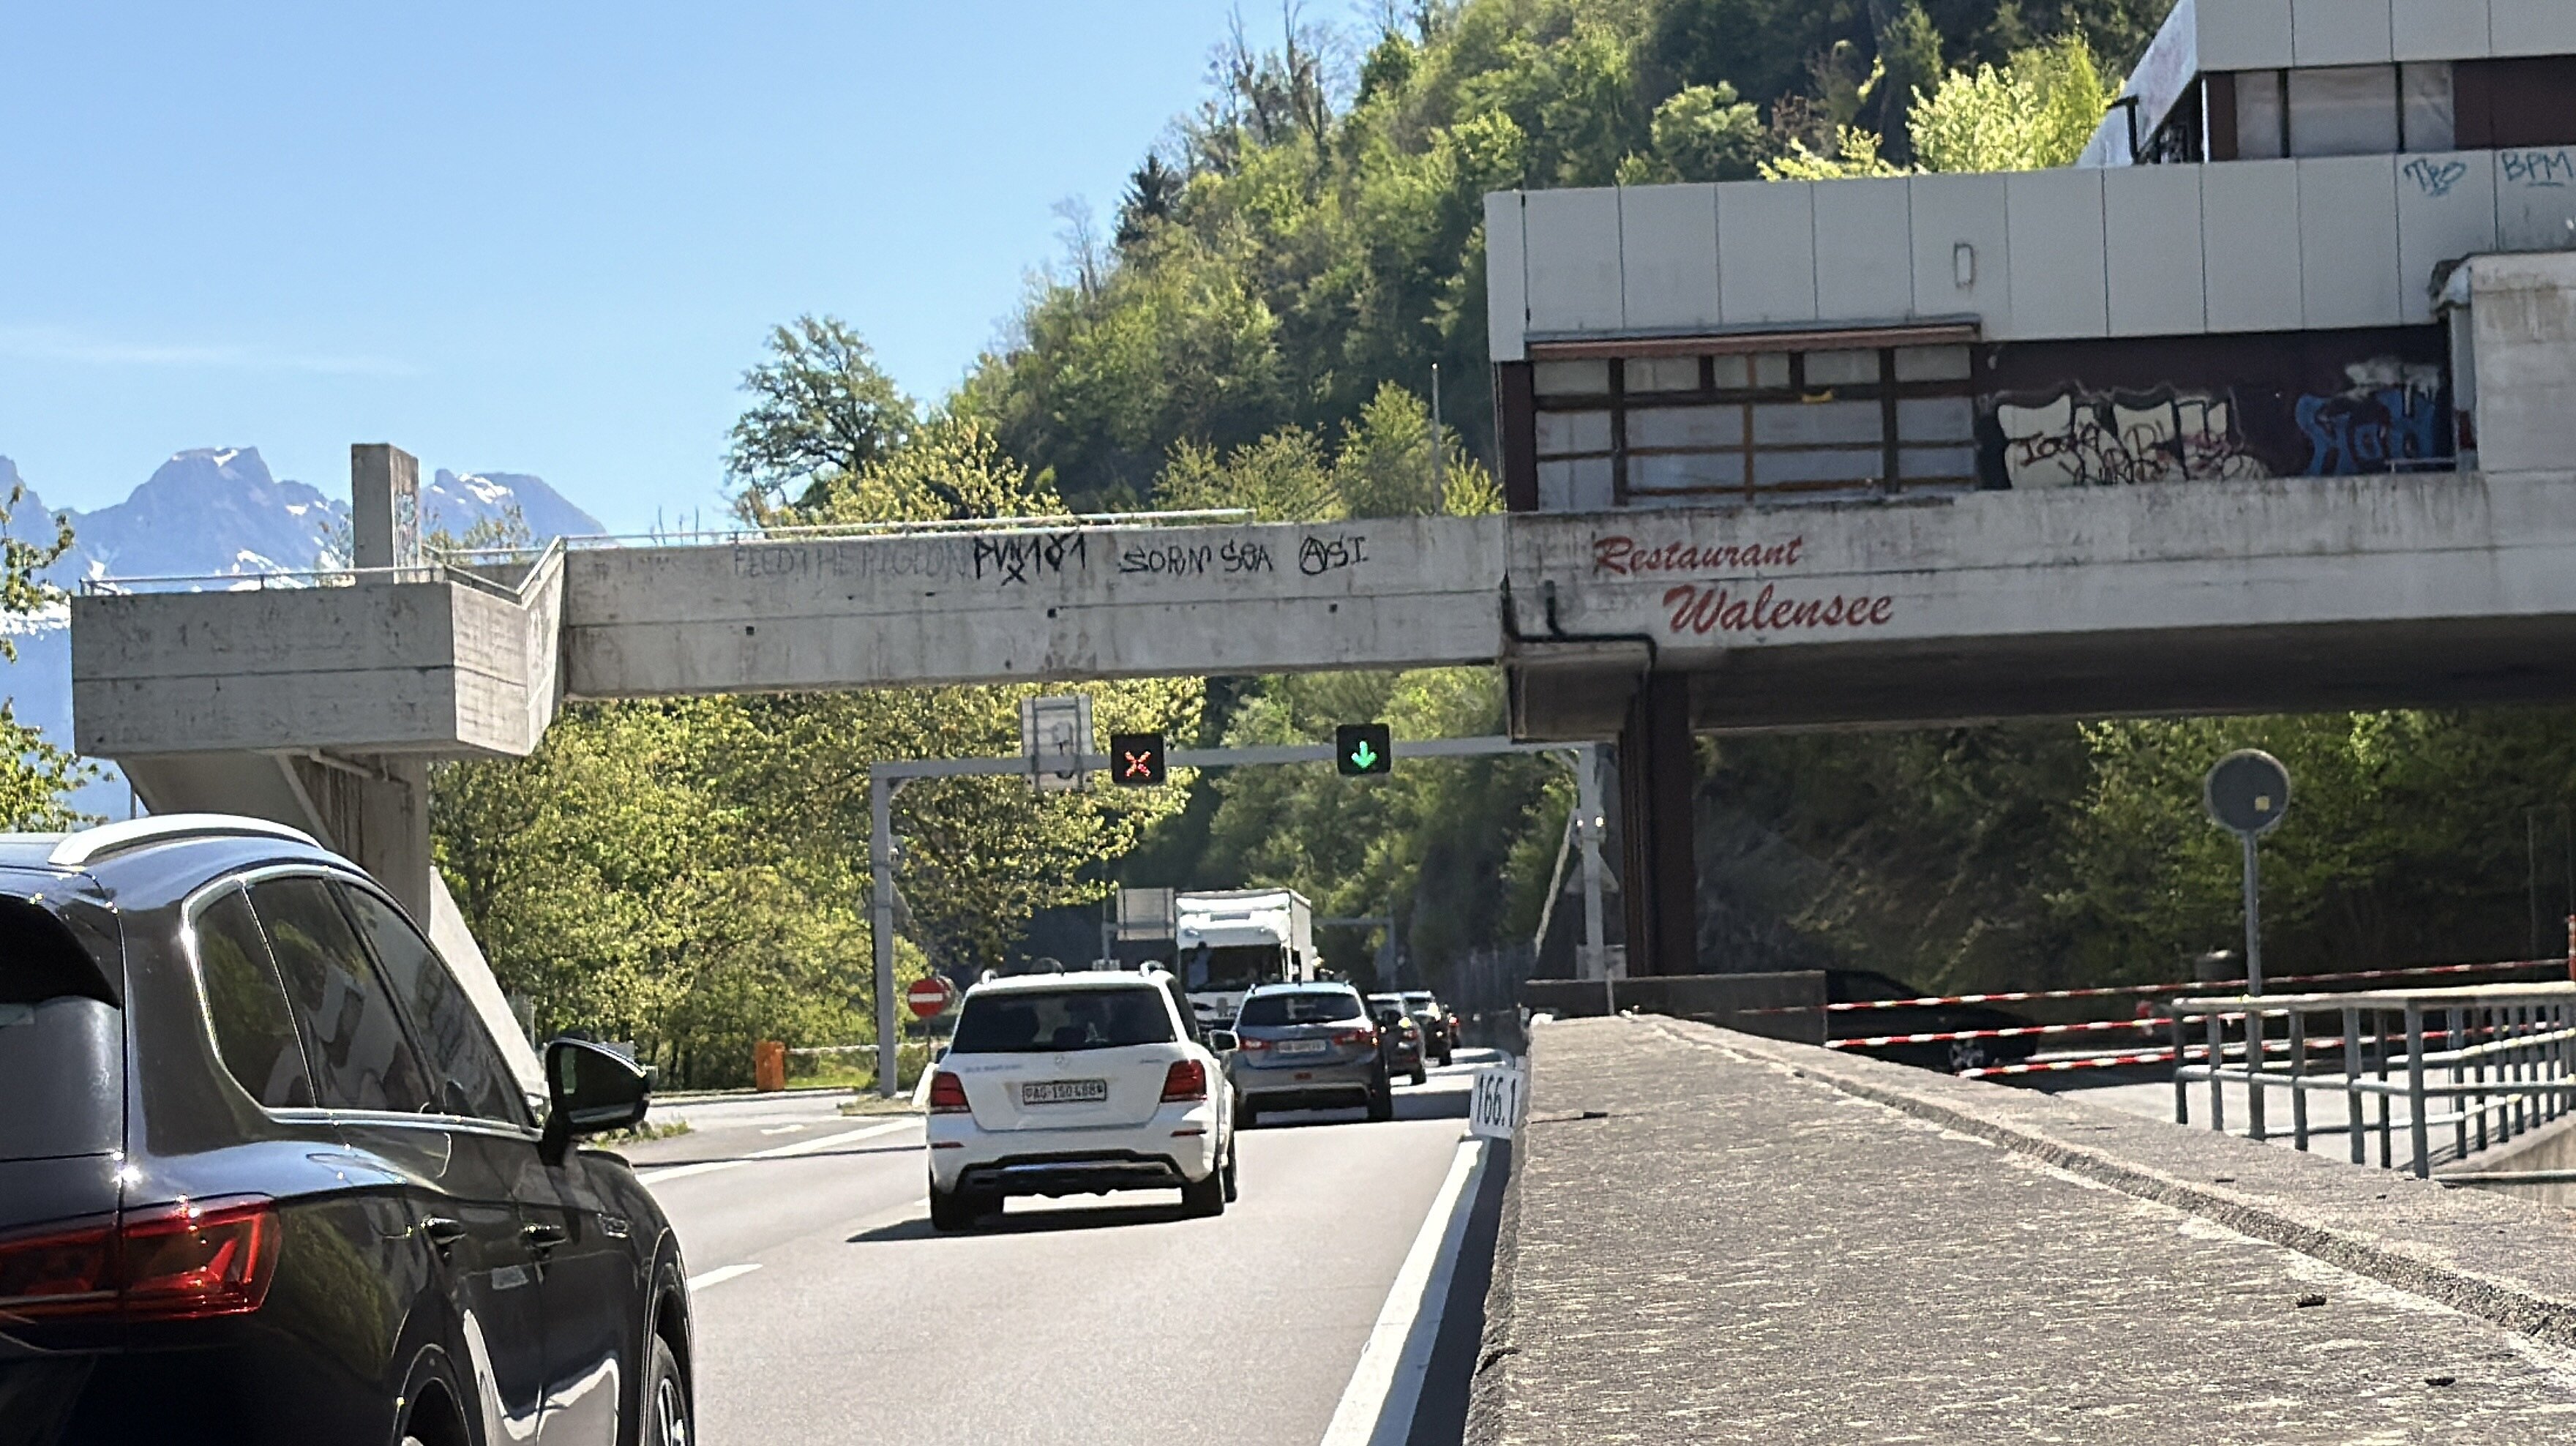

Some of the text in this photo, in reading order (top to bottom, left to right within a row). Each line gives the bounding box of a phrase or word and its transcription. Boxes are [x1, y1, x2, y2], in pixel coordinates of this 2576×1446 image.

[1594, 536, 1803, 575] Restaurant
[1663, 582, 1894, 635] Walensee
[1477, 1074, 1516, 1127] 166.1
